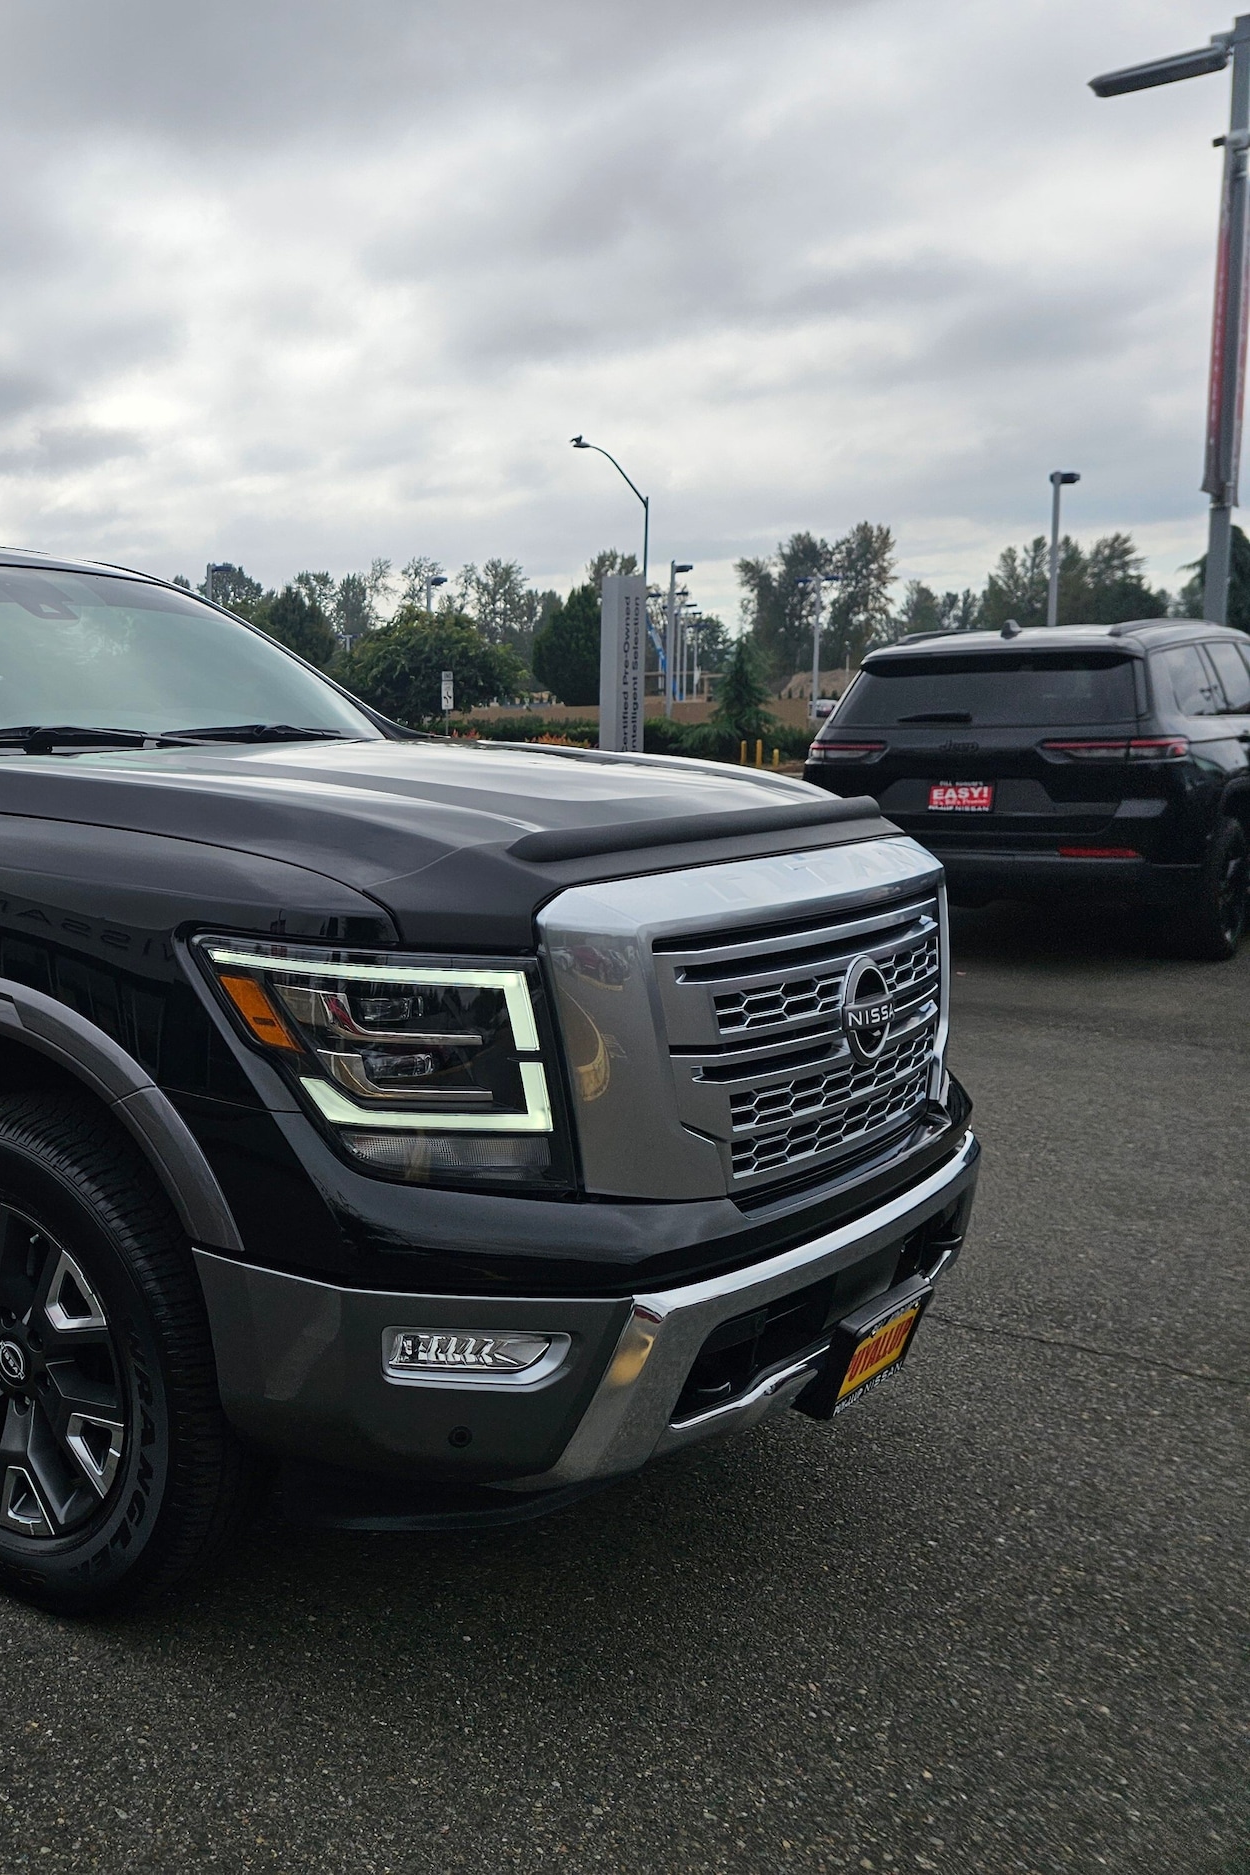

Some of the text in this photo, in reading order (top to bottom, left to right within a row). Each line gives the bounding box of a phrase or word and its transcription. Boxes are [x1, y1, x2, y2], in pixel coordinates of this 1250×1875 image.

[622, 596, 630, 685] Pre-Owned
[632, 596, 640, 670] Selection
[933, 786, 988, 800] EASY!
[848, 1003, 894, 1026] NISSA
[0, 1340, 26, 1380] NISSAN
[864, 1360, 903, 1394] NISSAN
